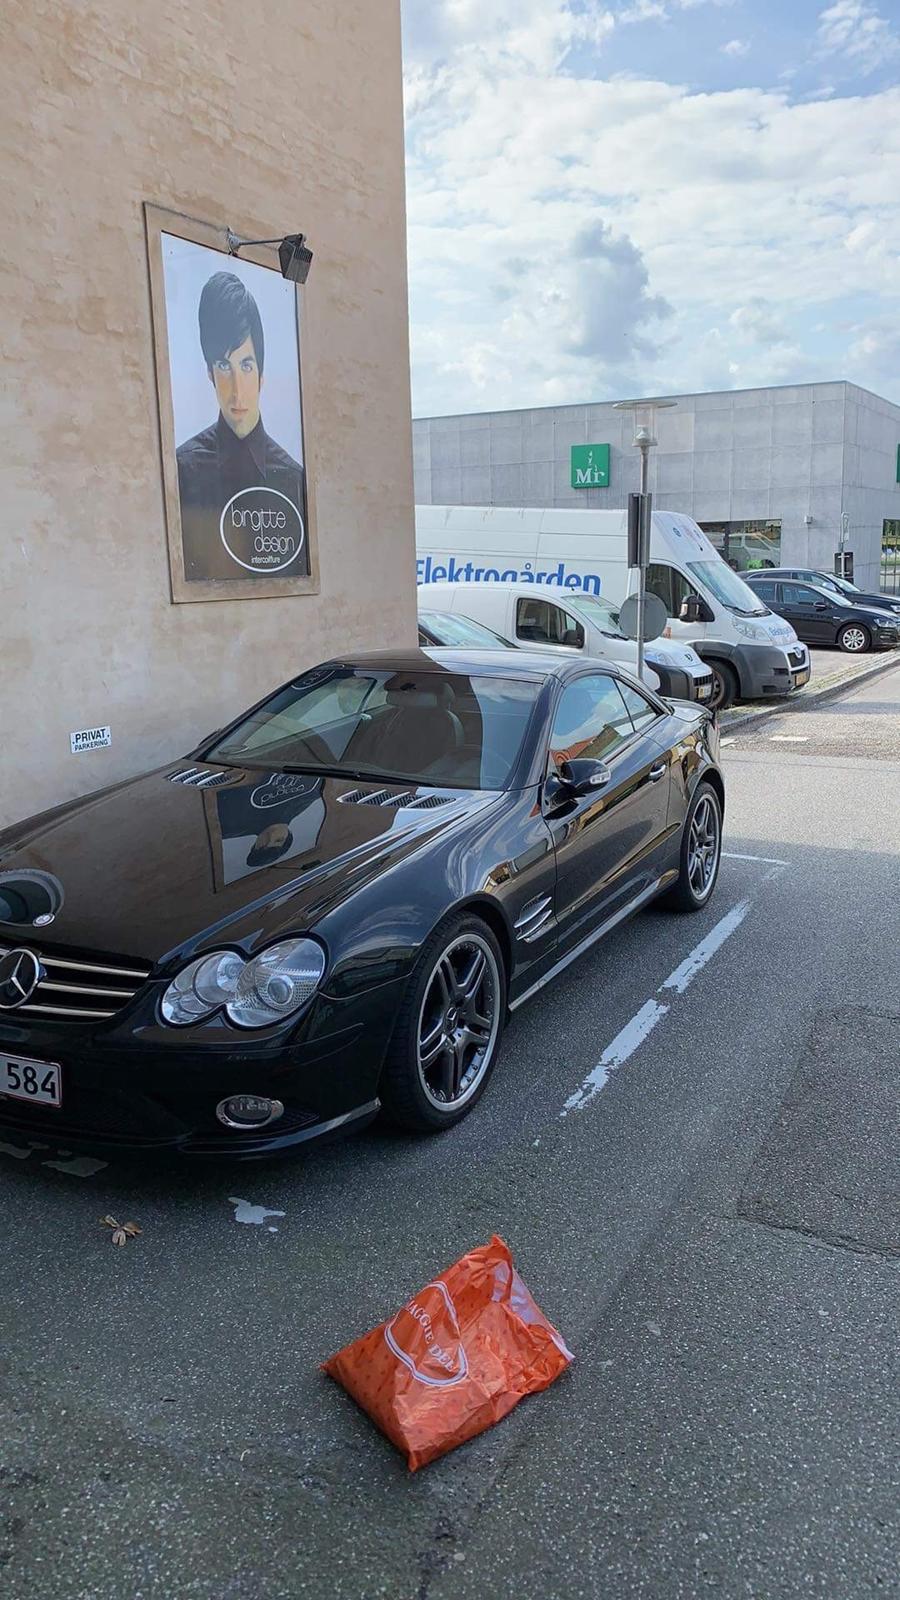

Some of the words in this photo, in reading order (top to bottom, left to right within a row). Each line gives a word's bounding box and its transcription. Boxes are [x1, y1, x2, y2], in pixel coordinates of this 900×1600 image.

[254, 532, 295, 555] design
[74, 738, 109, 752] PARKERING
[75, 728, 106, 743] PRIVAT
[6, 1062, 56, 1099] 584
